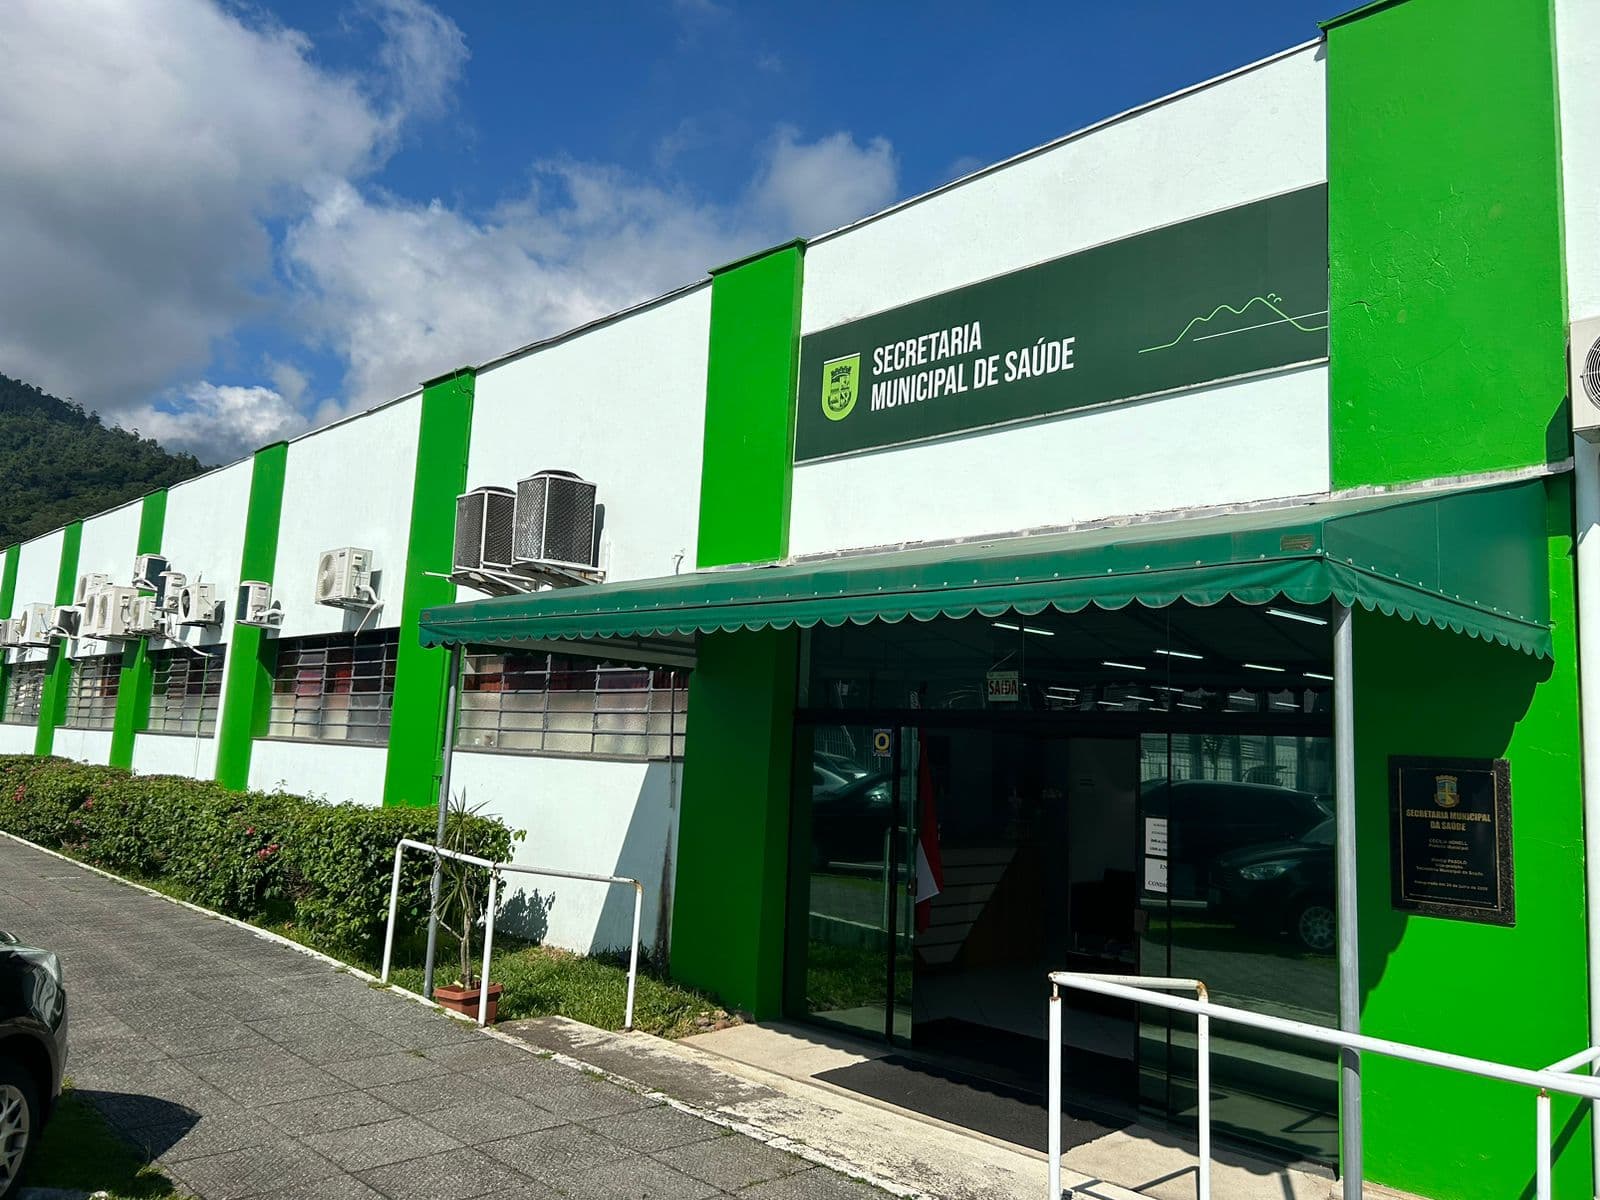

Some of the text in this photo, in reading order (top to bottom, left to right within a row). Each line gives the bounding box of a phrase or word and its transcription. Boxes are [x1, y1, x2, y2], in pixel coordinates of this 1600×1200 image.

[872, 321, 982, 376] SECRETARIA
[871, 337, 1075, 411] MUNICIPAL DE SAÚDE
[1406, 809, 1491, 823] SECRETARIA MUNICIPAL
[1430, 820, 1441, 829] DA
